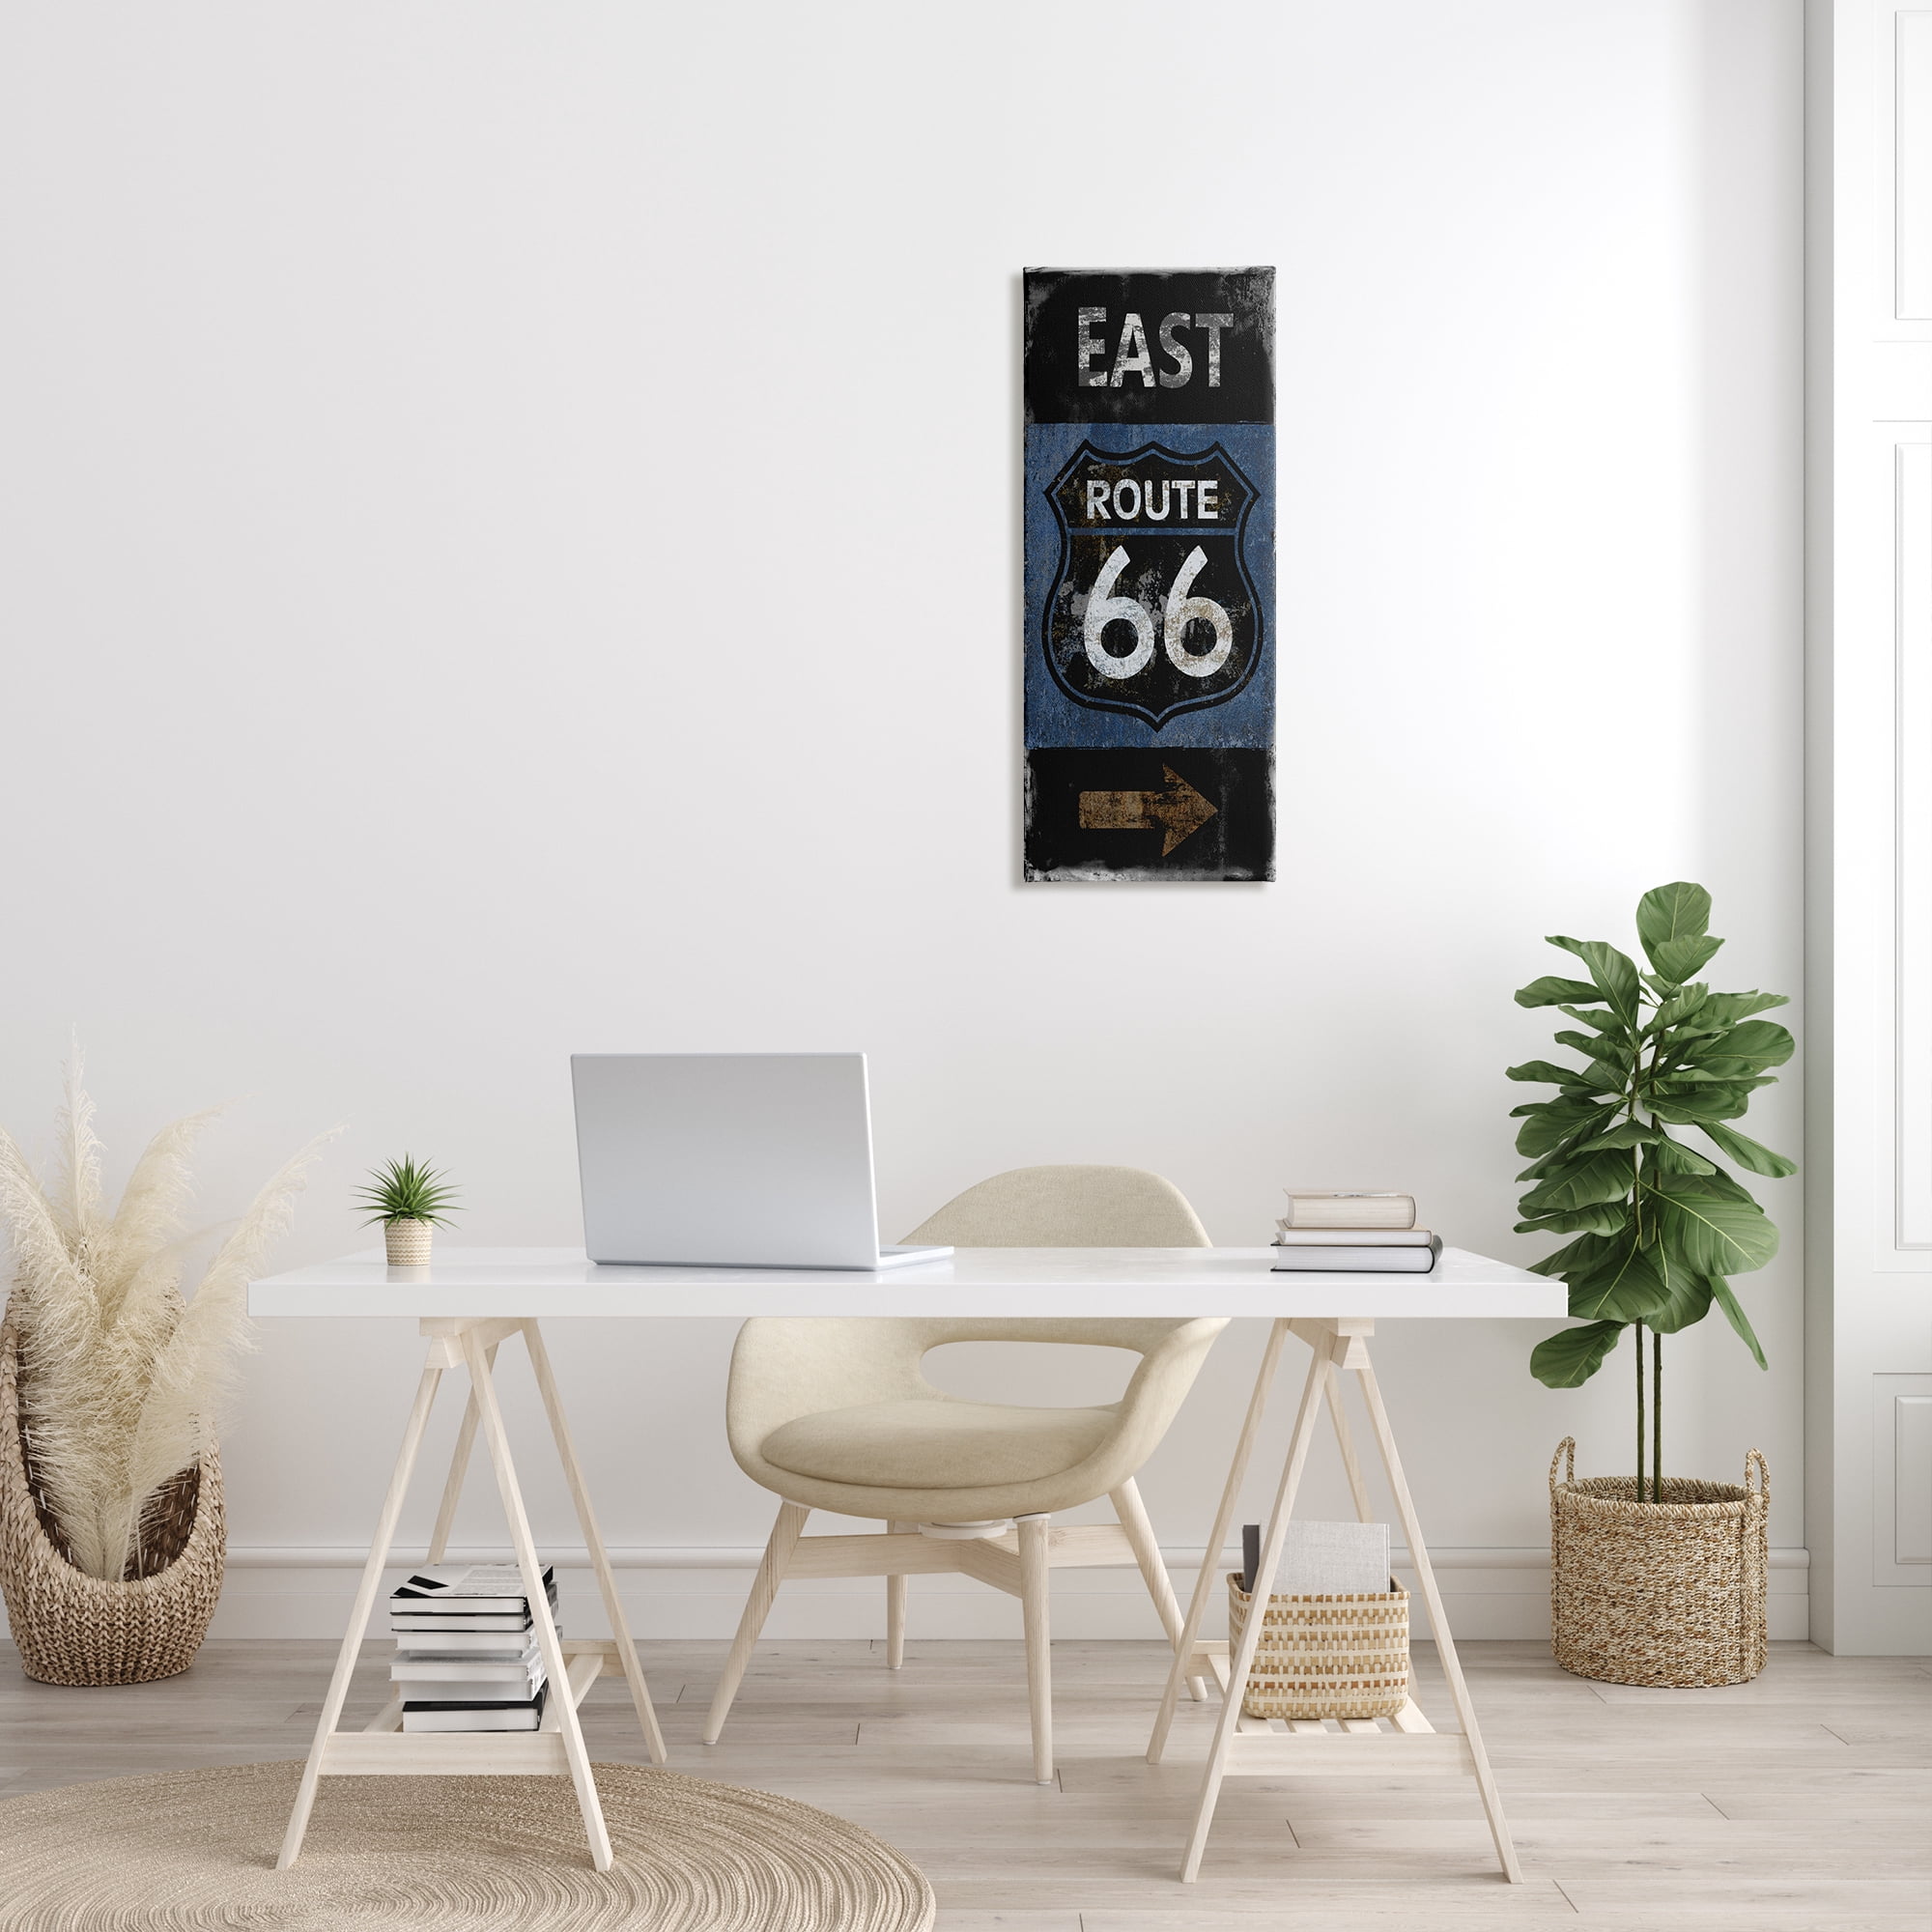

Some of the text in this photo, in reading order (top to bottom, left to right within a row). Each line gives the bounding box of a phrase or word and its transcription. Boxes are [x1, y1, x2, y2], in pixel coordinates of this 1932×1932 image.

[1078, 306, 1234, 388] EAST
[1086, 478, 1218, 520] ROUTE
[1084, 545, 1233, 678] 66
